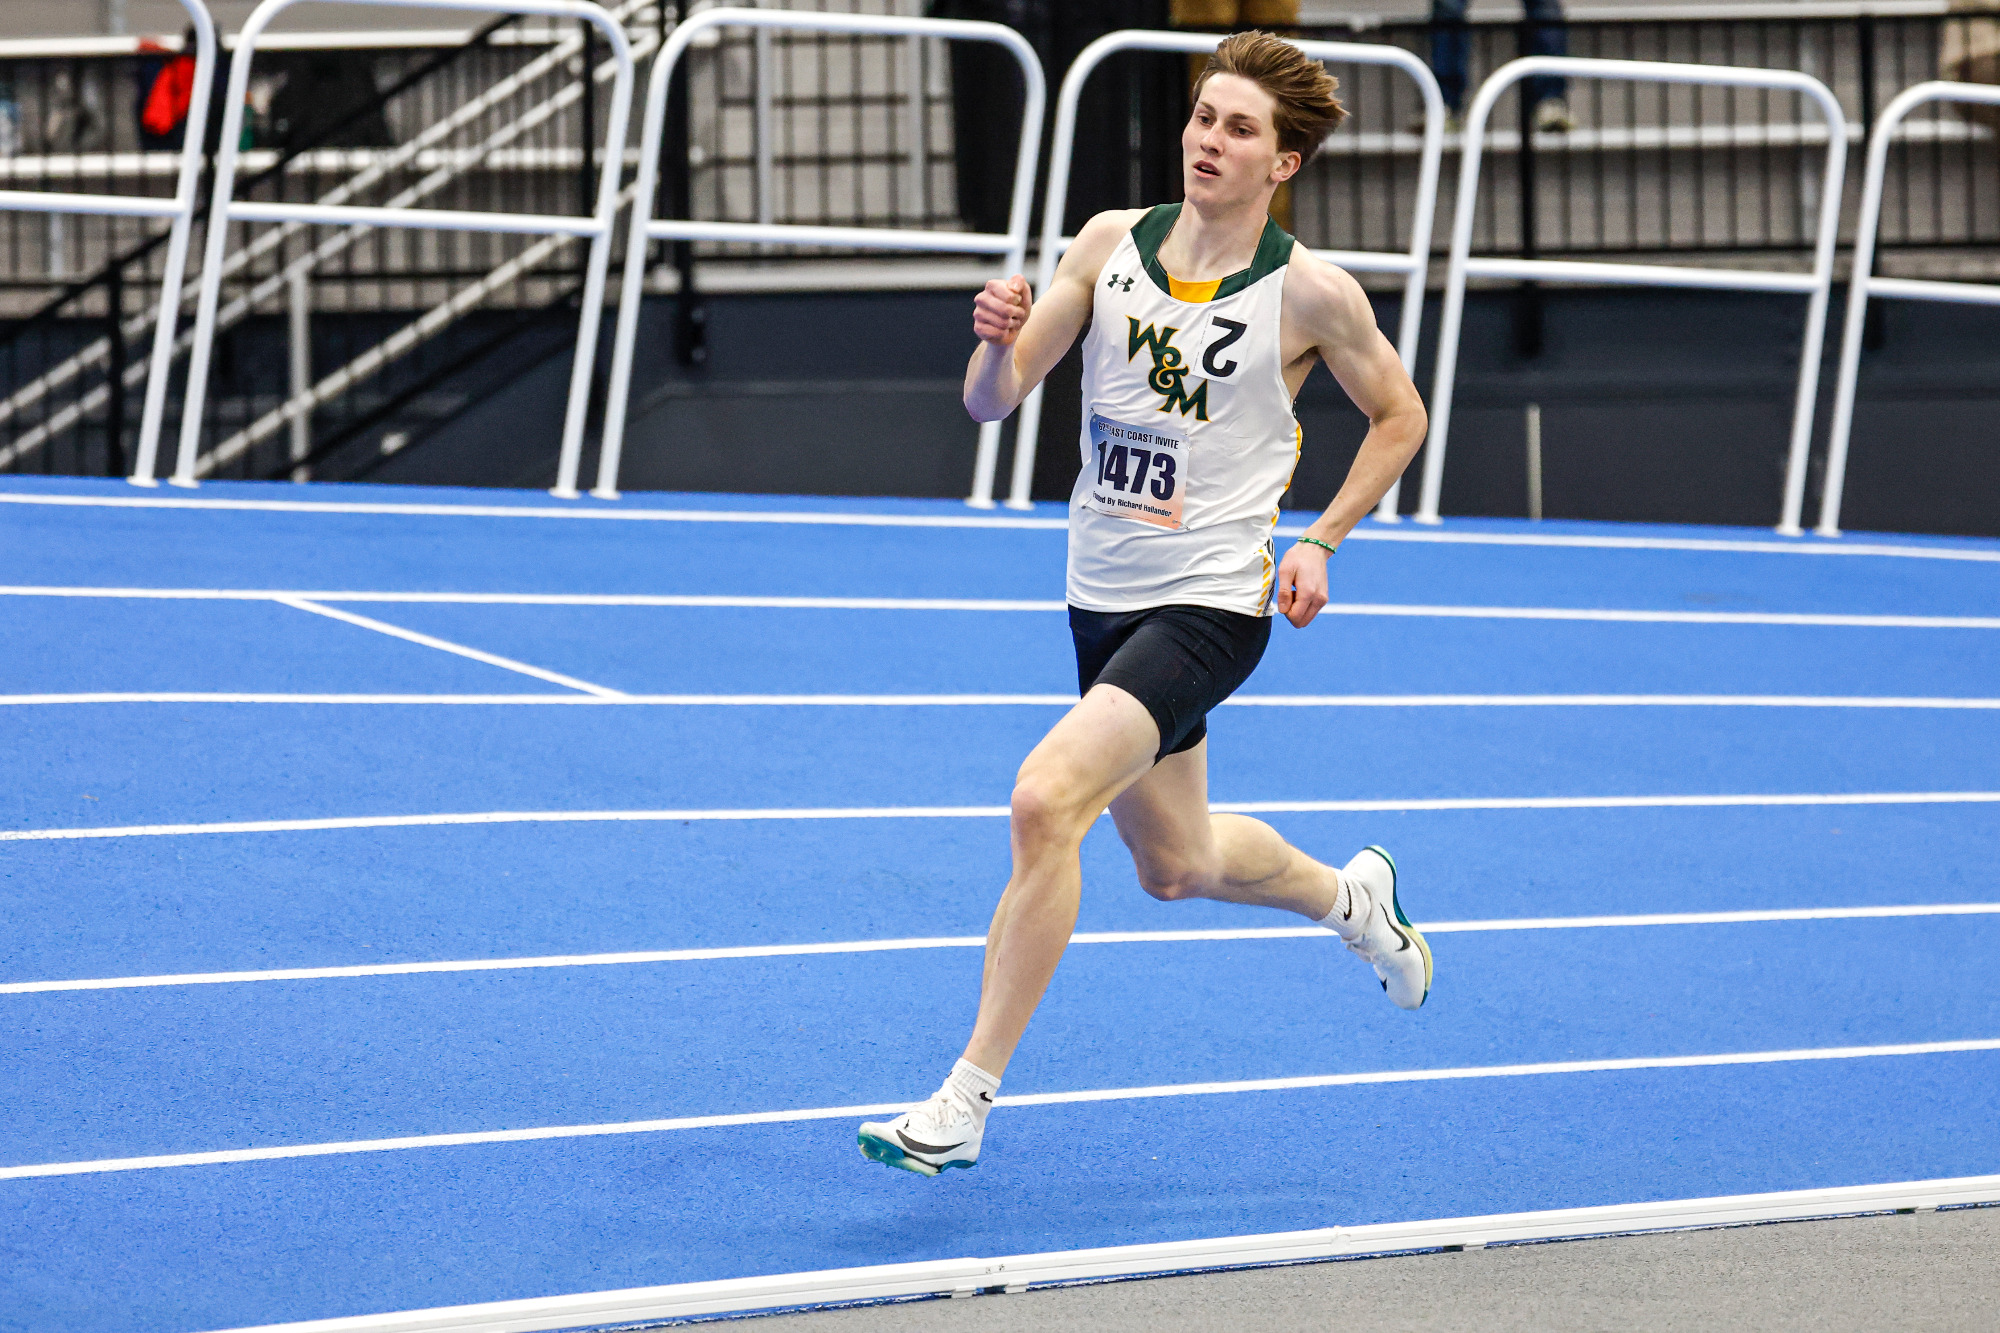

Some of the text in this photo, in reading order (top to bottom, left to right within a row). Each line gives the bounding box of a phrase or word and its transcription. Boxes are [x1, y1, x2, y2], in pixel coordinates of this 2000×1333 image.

[1126, 314, 1211, 422] W&M
[1127, 430, 1153, 443] COAST
[1155, 436, 1179, 449] INVITE
[1097, 440, 1176, 501] 1473
[1107, 497, 1116, 506] By
[1117, 498, 1142, 510] Richard
[1143, 504, 1172, 517] Hollander
